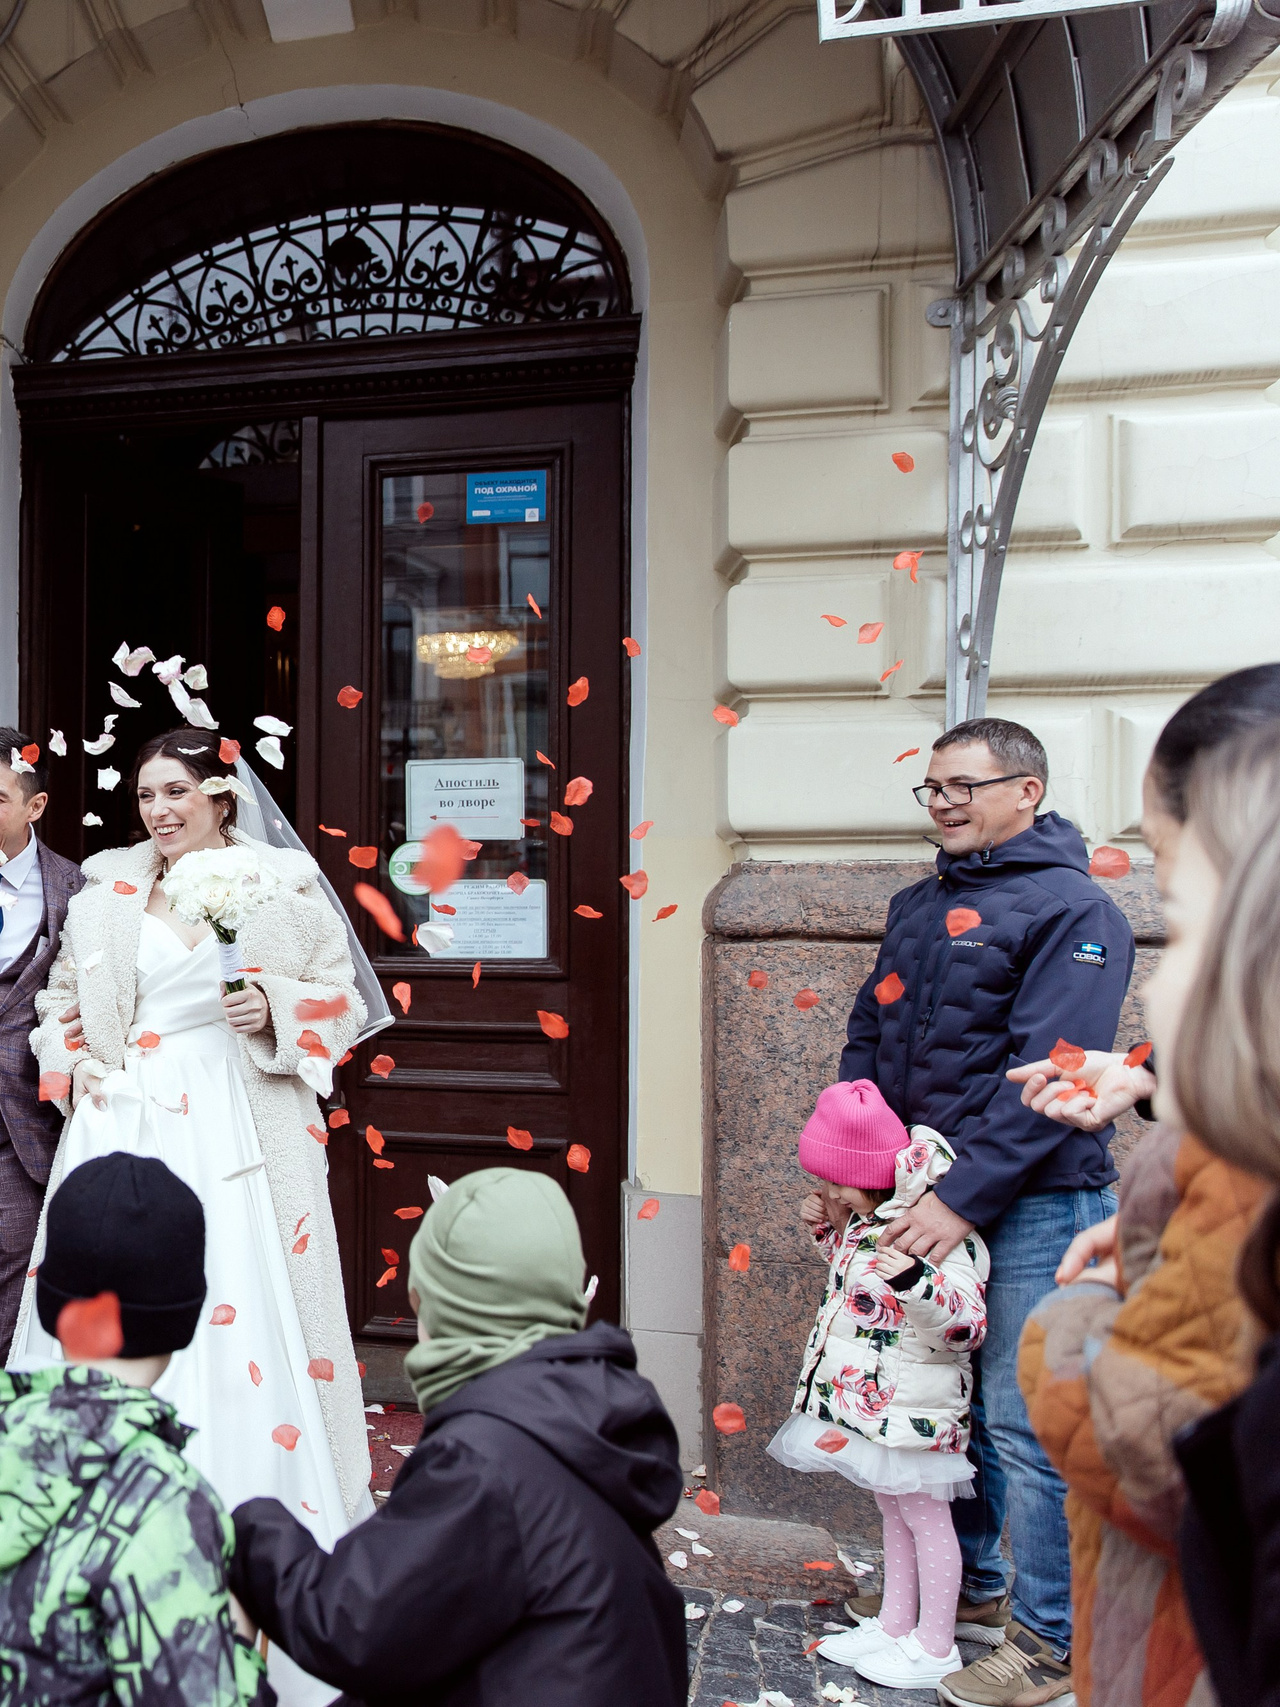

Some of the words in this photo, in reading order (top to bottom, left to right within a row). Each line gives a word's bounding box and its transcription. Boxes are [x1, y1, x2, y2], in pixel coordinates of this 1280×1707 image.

[474, 487, 493, 495] ПОД
[495, 484, 537, 494] ОХРАНОЙ
[435, 778, 499, 788] Апостиль
[439, 799, 454, 808] во
[457, 798, 496, 809] дворе
[1073, 952, 1106, 964] COBOLT
